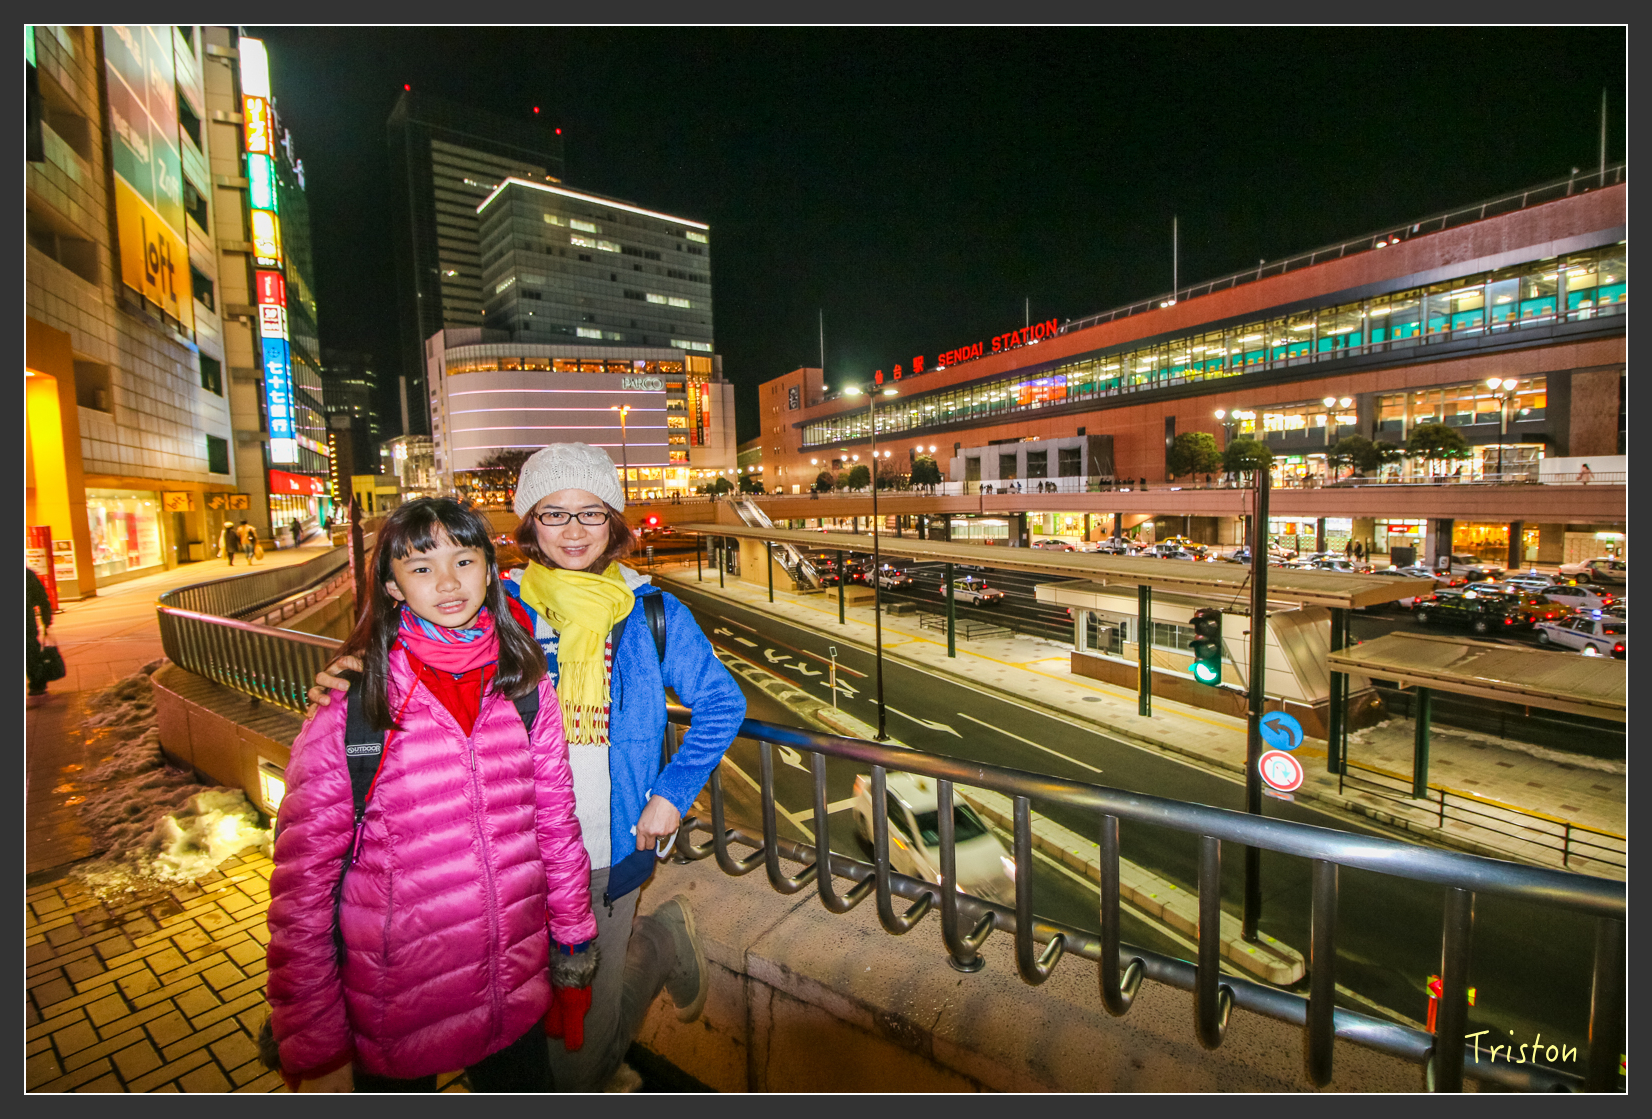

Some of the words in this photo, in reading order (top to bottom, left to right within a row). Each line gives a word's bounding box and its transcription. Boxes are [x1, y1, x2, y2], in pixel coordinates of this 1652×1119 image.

[938, 341, 983, 367] SENDAI
[991, 318, 1058, 351] STATION
[874, 355, 924, 385] 仙台駅
[622, 376, 664, 391] PARCO
[347, 745, 381, 754] OUTDOOR
